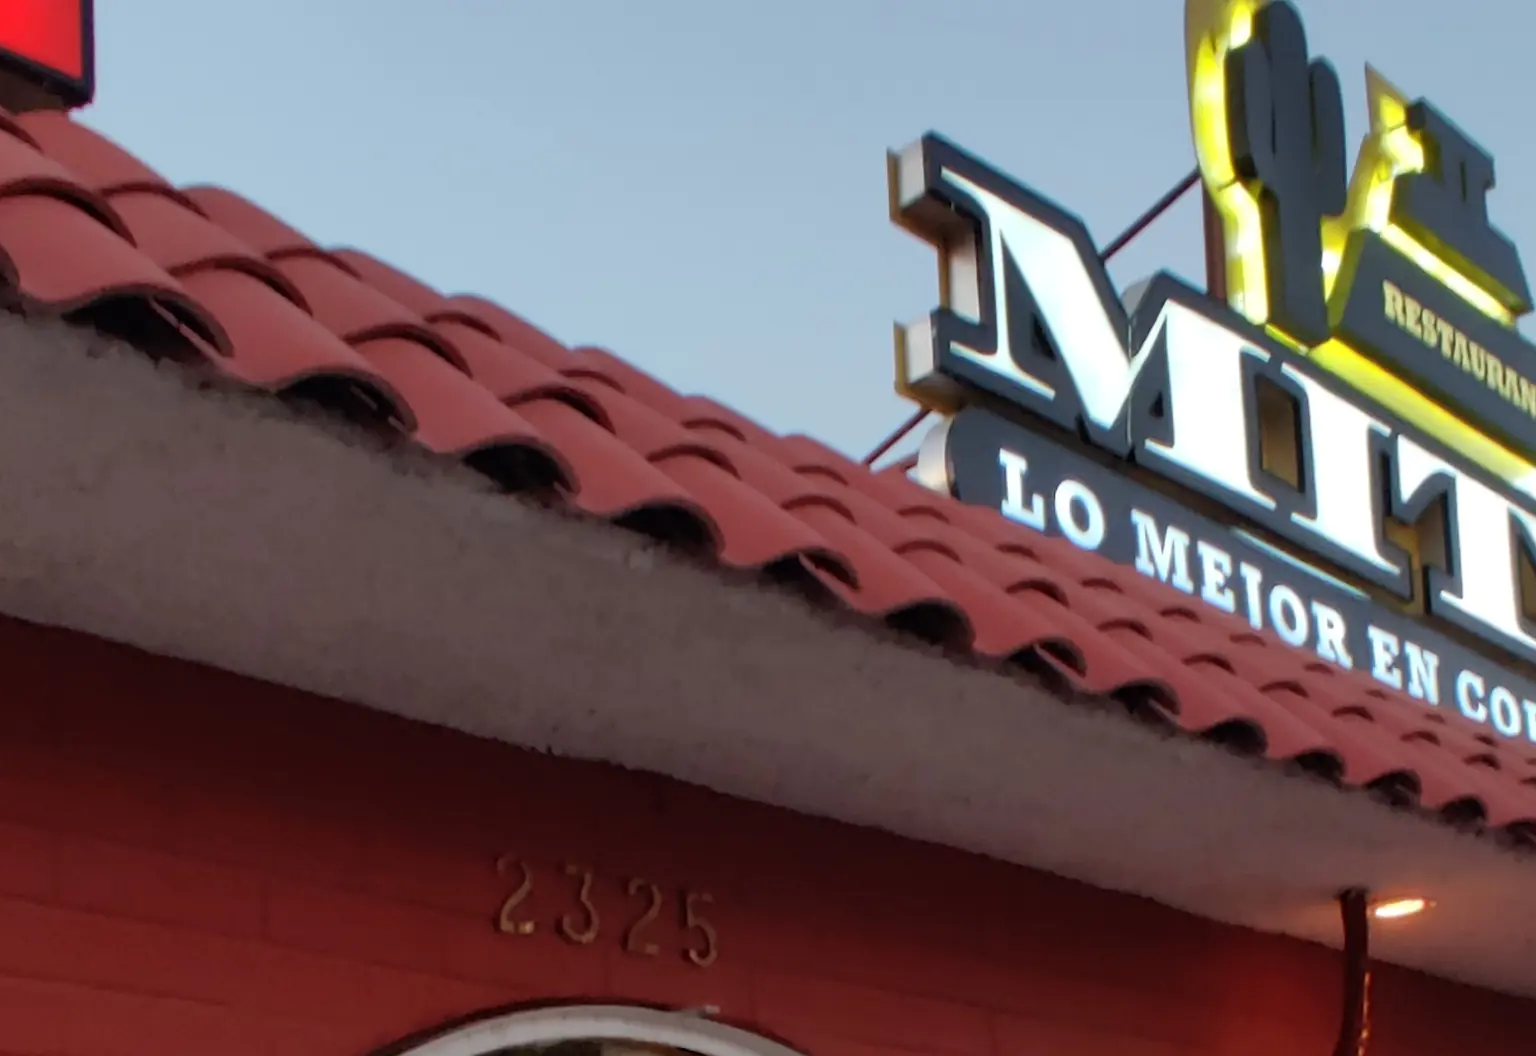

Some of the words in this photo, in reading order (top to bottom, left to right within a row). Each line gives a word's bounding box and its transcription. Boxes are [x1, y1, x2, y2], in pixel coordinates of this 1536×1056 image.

[999, 447, 1106, 551] LO
[1131, 508, 1353, 669] MEJOR
[1367, 624, 1440, 706] EN
[495, 855, 718, 968] 2325
